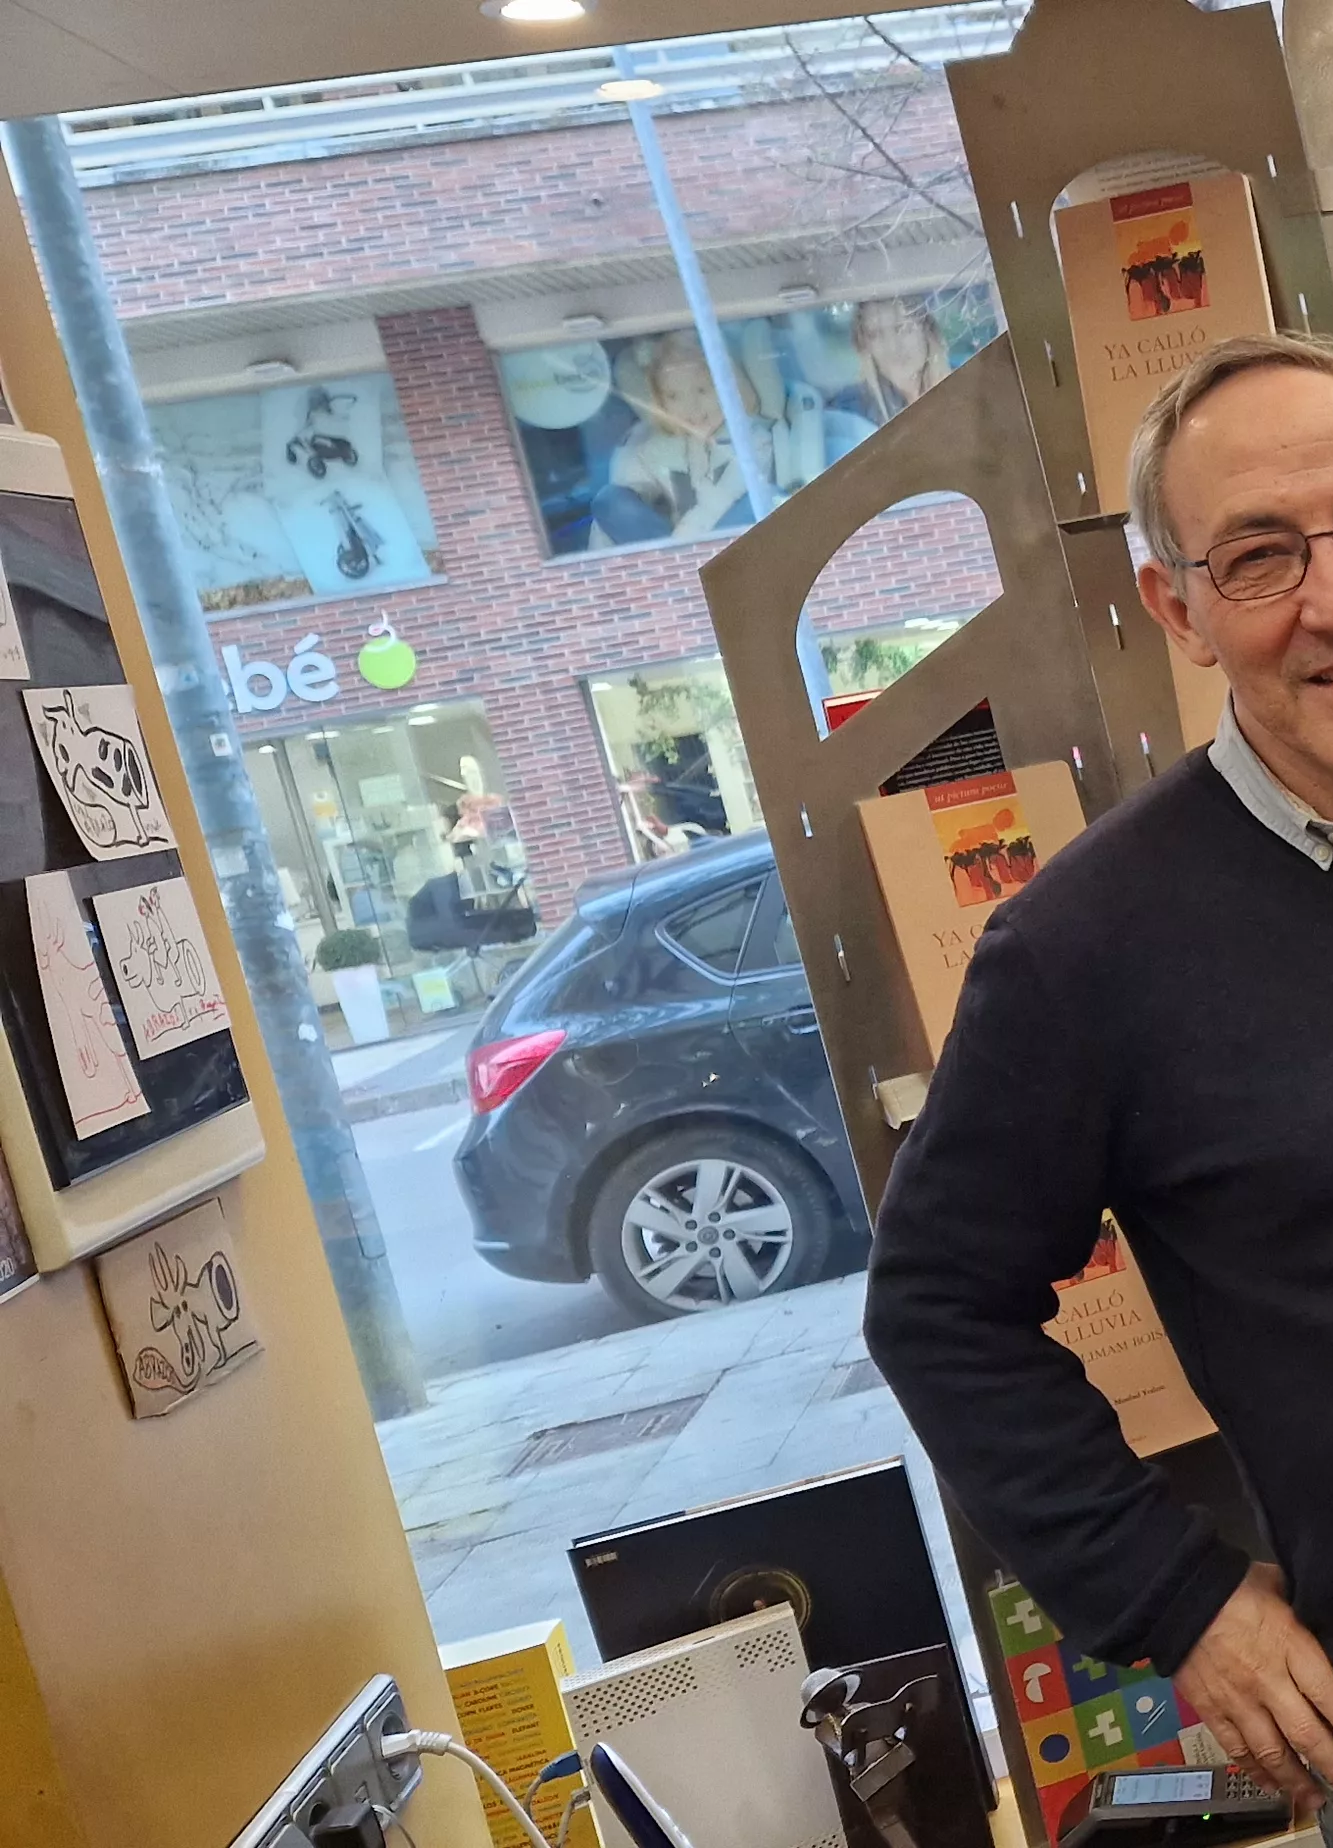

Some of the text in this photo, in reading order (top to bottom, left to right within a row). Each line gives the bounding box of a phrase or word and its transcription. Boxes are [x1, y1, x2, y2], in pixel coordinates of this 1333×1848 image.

[1104, 324, 1206, 361] YA CALLÓ
[1111, 363, 1138, 382] LA
[932, 930, 963, 948] YA
[1054, 1288, 1125, 1326] CALLÓ
[1064, 1308, 1143, 1346] LLUVIA
